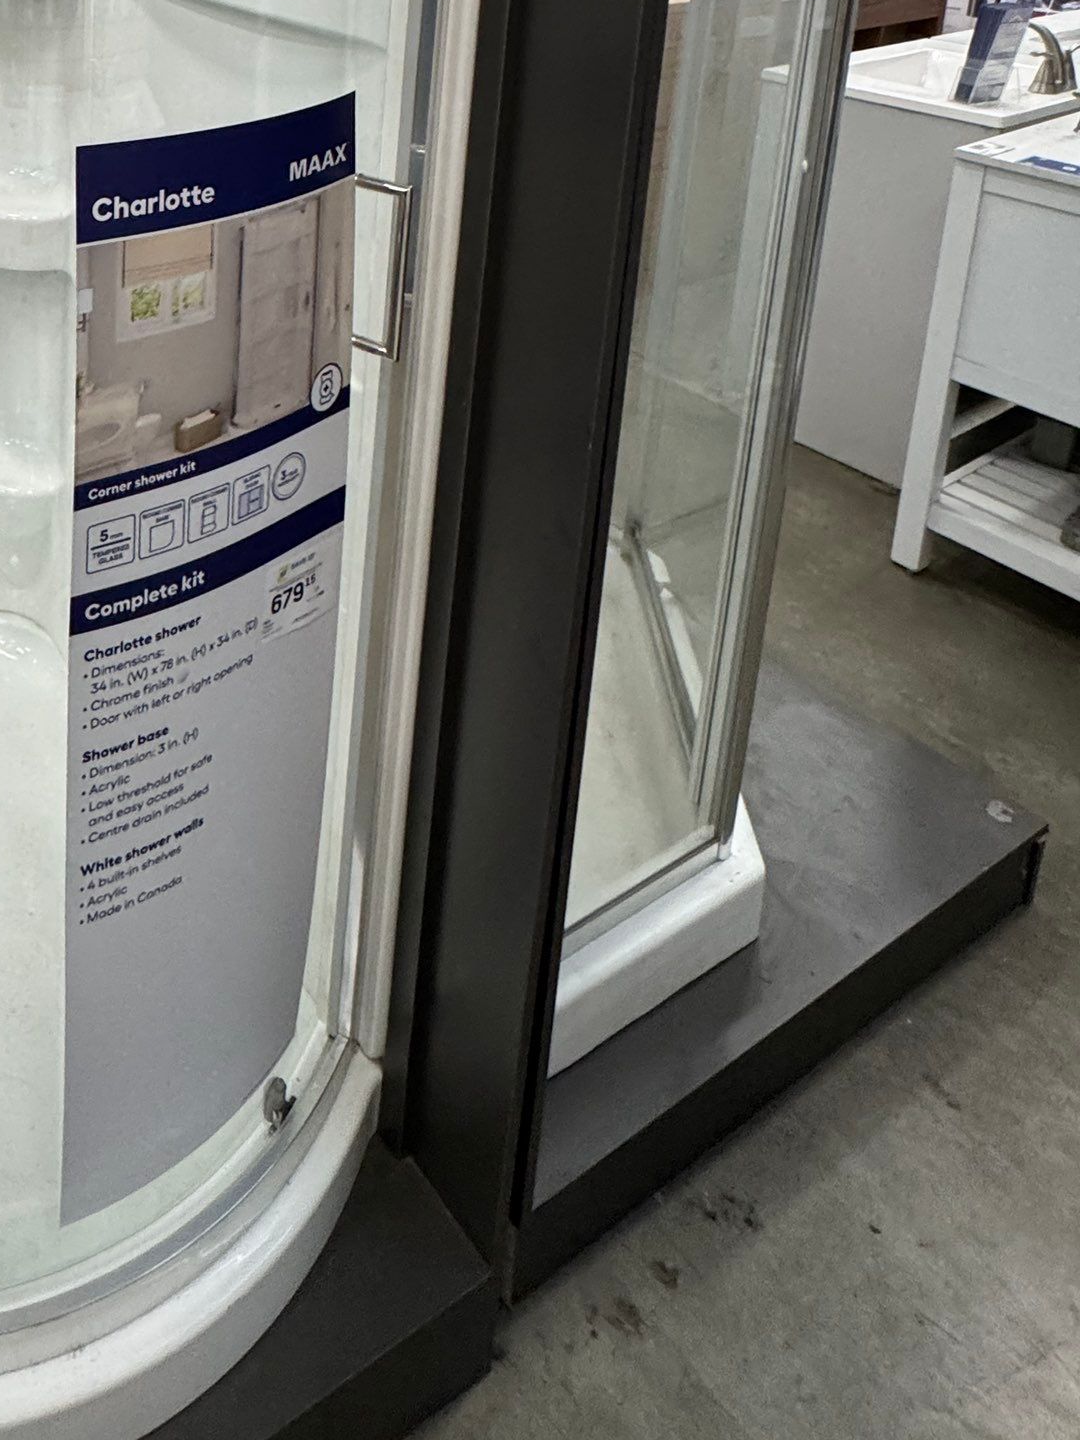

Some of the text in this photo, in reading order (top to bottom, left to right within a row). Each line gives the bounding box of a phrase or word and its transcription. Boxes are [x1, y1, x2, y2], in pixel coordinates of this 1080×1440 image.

[289, 143, 347, 182] MAAX
[91, 186, 216, 222] Charlotte
[88, 461, 196, 500] Corner shower kit
[100, 529, 108, 542] 5
[85, 570, 205, 620] Complete kit
[83, 616, 202, 662] Charlotte shower
[90, 682, 107, 694] 34
[110, 677, 124, 689] in.
[127, 668, 148, 686] (W)
[151, 667, 158, 675] x
[160, 659, 174, 672] 78
[175, 655, 188, 666] in.
[191, 644, 207, 661] (H)
[209, 644, 214, 652] x
[217, 634, 230, 647] 34
[231, 628, 243, 640] in.
[245, 617, 259, 635] (D)
[91, 649, 165, 679] Dimensions:
[90, 654, 253, 730] Door with left or right opening
[90, 677, 174, 712] Chrome finish
[82, 726, 169, 763] Shower base
[89, 727, 199, 779] Dimension: 3 in. (H)
[88, 775, 131, 795] Acrylic
[89, 754, 213, 812] Low threshold for safe
[88, 784, 184, 827] and easy access
[88, 784, 209, 843] Centre drain included
[80, 817, 204, 876] White shower walls
[87, 845, 182, 890] 4 built-in shelves
[87, 886, 128, 908] Acrylic
[87, 876, 183, 924] Made in Canada
